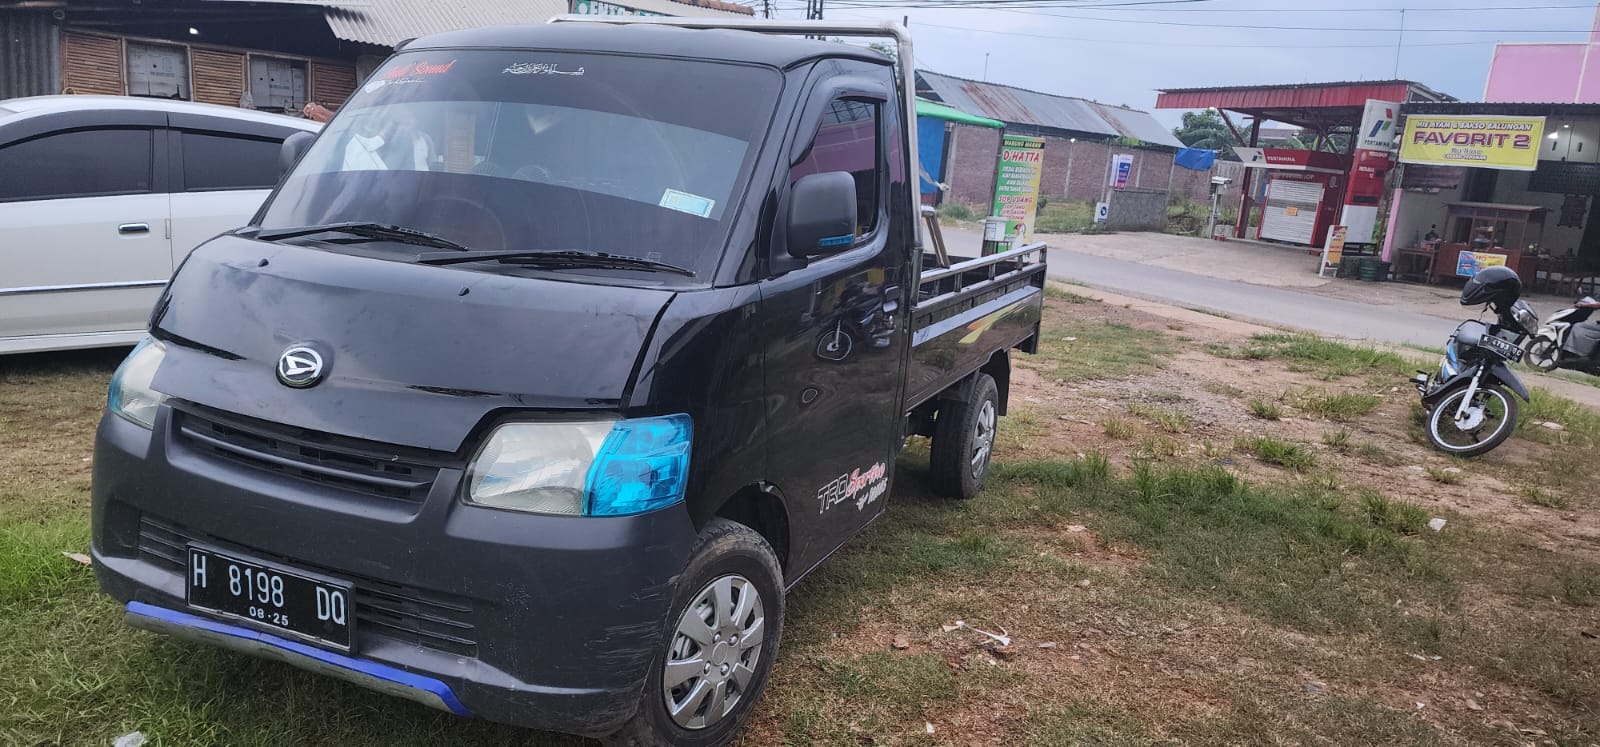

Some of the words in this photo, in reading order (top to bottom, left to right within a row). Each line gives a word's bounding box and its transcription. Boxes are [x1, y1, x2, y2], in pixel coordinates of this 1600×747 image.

[1430, 121, 1451, 129] AYAM
[1459, 121, 1486, 130] BAKSO
[1413, 131, 1510, 148] FAVORIT
[1512, 134, 1531, 149] 2
[1003, 150, 1040, 162] D'HATTA
[193, 553, 207, 588] H
[228, 564, 285, 608] 8198
[315, 585, 346, 626] DQ
